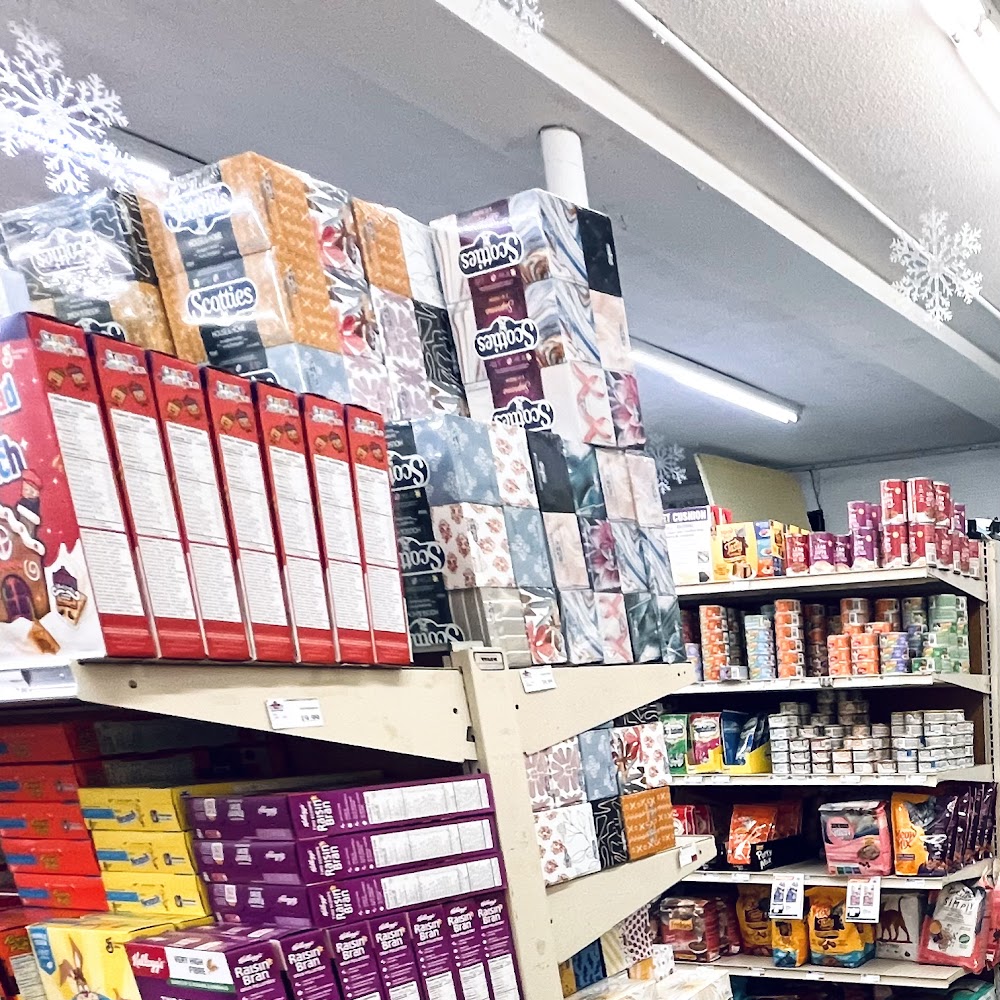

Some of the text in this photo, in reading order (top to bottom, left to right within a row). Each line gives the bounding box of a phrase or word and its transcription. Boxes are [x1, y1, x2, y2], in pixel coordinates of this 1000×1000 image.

[461, 234, 521, 270] Scotties
[188, 285, 255, 314] Scotties
[476, 321, 535, 353] Scotties
[672, 510, 706, 522] CUSHION
[313, 800, 328, 832] Raisin
[322, 800, 335, 826] Bran
[322, 844, 336, 876] Raisin
[330, 845, 343, 870] Bran
[332, 888, 346, 920] Raisin
[340, 889, 354, 914] Bran
[447, 912, 472, 926] Raisin
[478, 904, 501, 918] Raisin
[482, 913, 500, 925] Bran
[414, 920, 440, 934] Raisin
[420, 928, 440, 942] Bran
[452, 921, 472, 933] Bran
[375, 928, 404, 943] Raisin
[336, 938, 364, 954] Raisin
[380, 937, 404, 951] Bran
[288, 948, 320, 965] Raisin
[342, 946, 365, 960] Bran
[234, 960, 270, 979] Raisin
[295, 957, 320, 972] Bran
[242, 970, 270, 986] Bran
